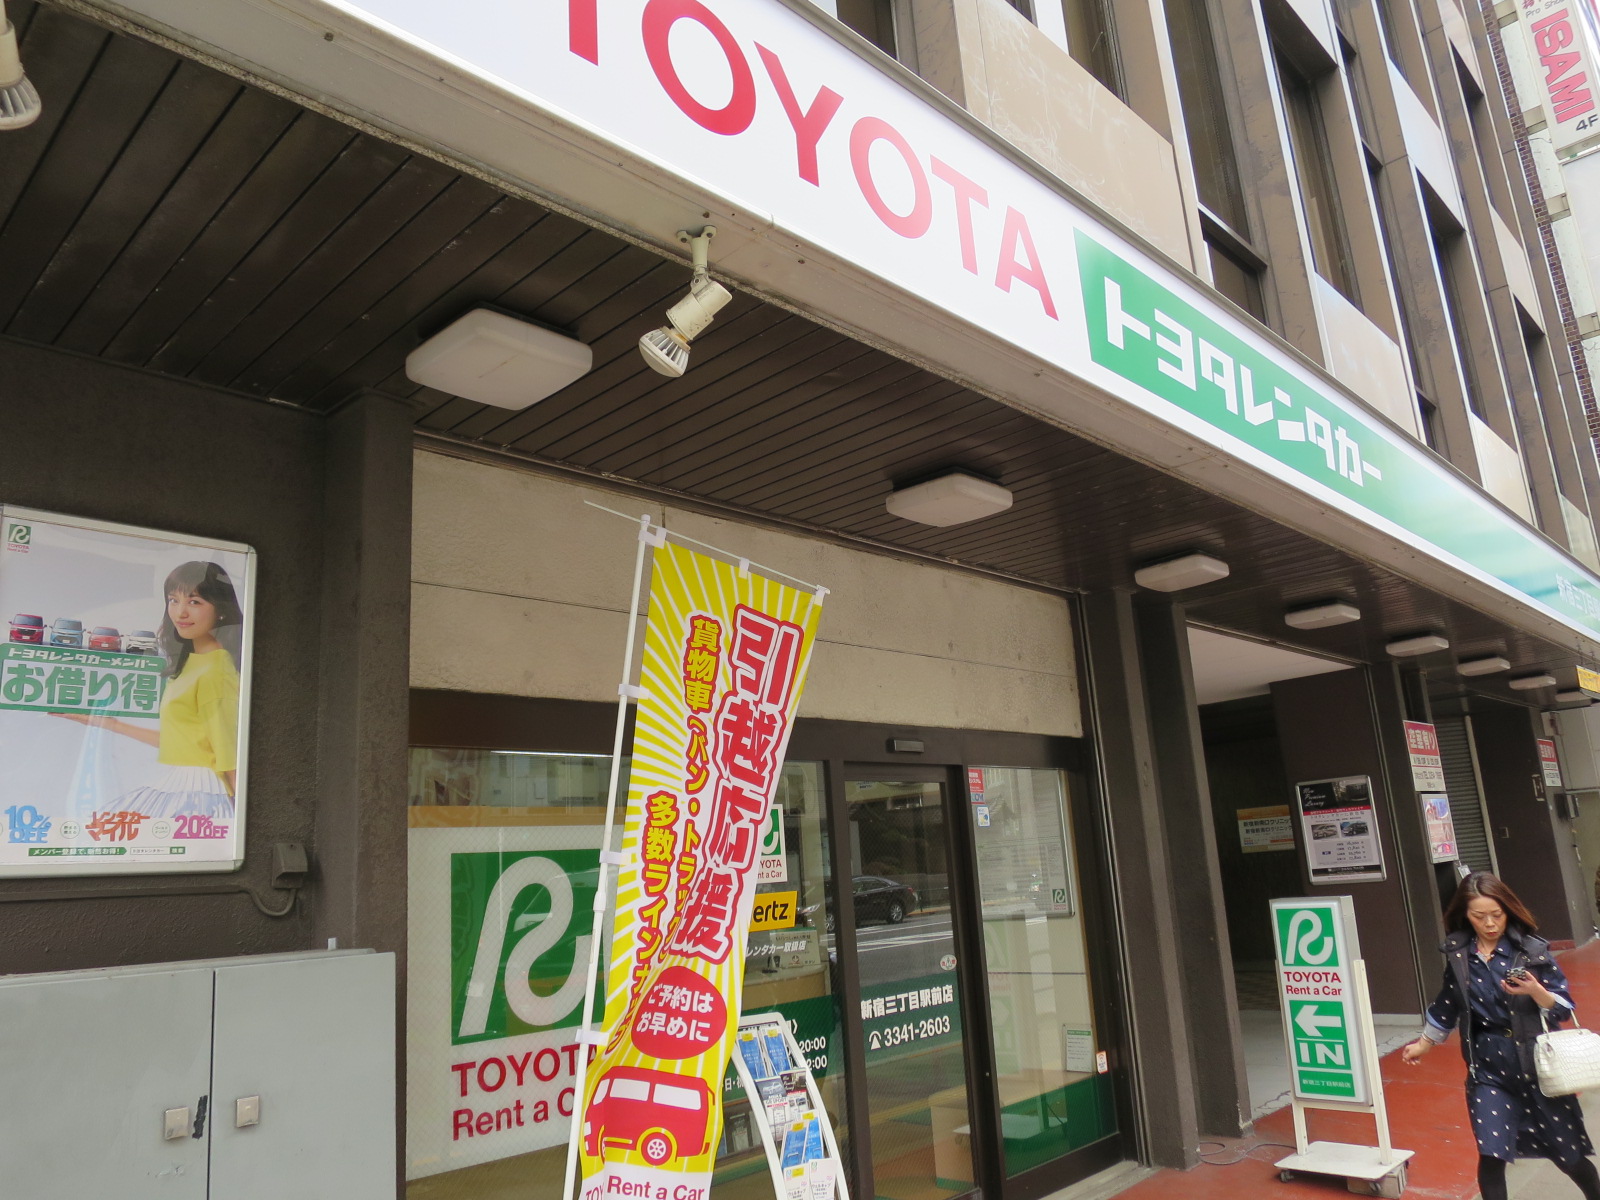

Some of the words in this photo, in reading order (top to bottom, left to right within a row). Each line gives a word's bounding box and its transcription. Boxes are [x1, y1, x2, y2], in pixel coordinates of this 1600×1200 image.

[1530, 8, 1595, 124] ISAMI
[1576, 114, 1598, 131] 4F
[1104, 276, 1382, 487] トヨタレンタカー
[8, 647, 158, 668] トヨタレンタカーメンバー
[3, 663, 158, 711] お借り得
[4, 805, 52, 830] 10%
[173, 815, 214, 839] 20%
[8, 829, 48, 843] OFF
[202, 825, 229, 839] OFF
[760, 859, 782, 869] YOTA
[771, 870, 782, 878] Car
[753, 901, 789, 923] ertz
[1284, 972, 1341, 983] TOYOTA
[648, 984, 714, 1015] ご予約は
[861, 984, 954, 1020] 新宿三丁目駅前店
[1286, 985, 1311, 995] Rent
[1313, 987, 1320, 995] a
[1322, 985, 1342, 996] Car
[636, 1010, 711, 1042] お早めに
[884, 1015, 951, 1047] 3341-2603
[806, 1055, 828, 1071] 2:00
[1299, 1042, 1345, 1066] IN
[453, 1099, 524, 1141] Rent
[533, 1100, 549, 1123] a
[607, 1175, 651, 1198] Rent
[656, 1186, 668, 1200] a
[673, 1184, 704, 1200] Car
